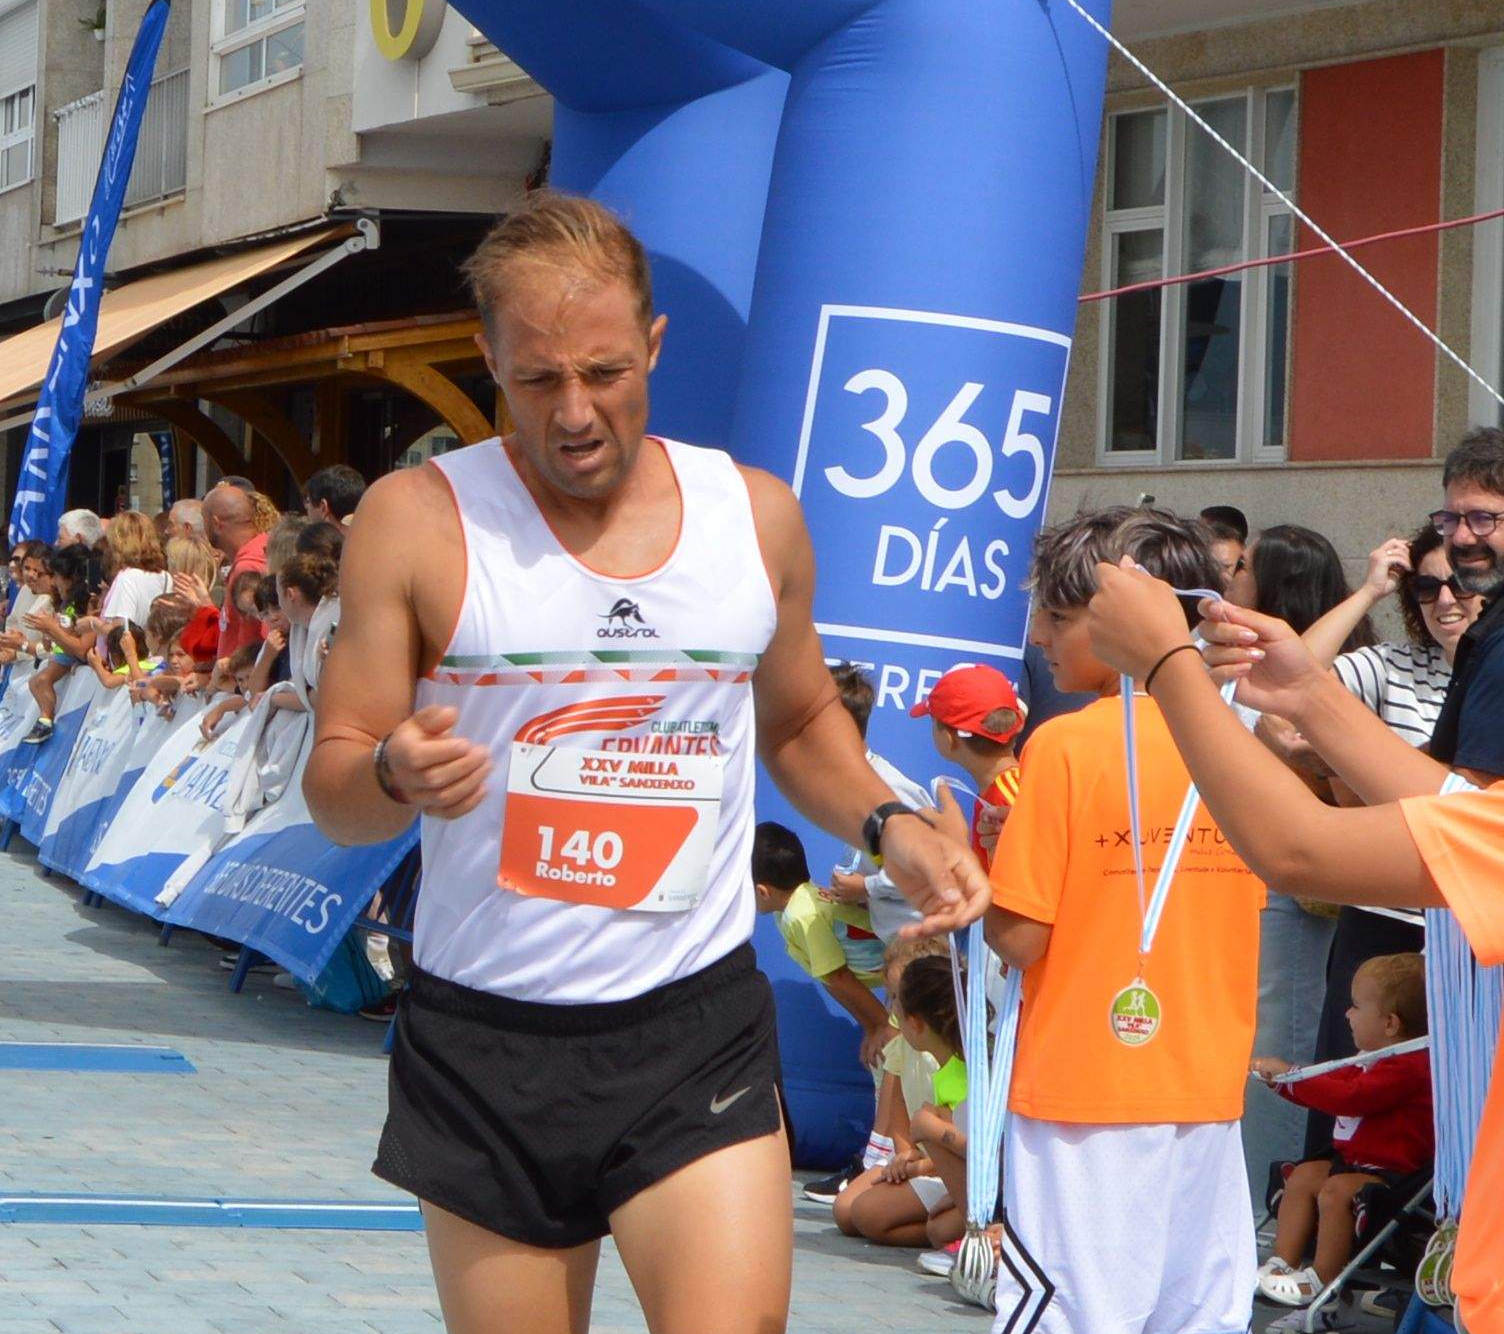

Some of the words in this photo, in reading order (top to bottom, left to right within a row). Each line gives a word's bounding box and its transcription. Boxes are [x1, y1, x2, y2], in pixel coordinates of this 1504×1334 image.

[824, 368, 1053, 519] 365
[871, 517, 1010, 600] DÍAS
[579, 756, 623, 773] XXV
[626, 760, 680, 776] MILLA
[618, 777, 695, 791] SANXENXO
[538, 825, 624, 870] 140
[535, 861, 617, 887] Roberto
